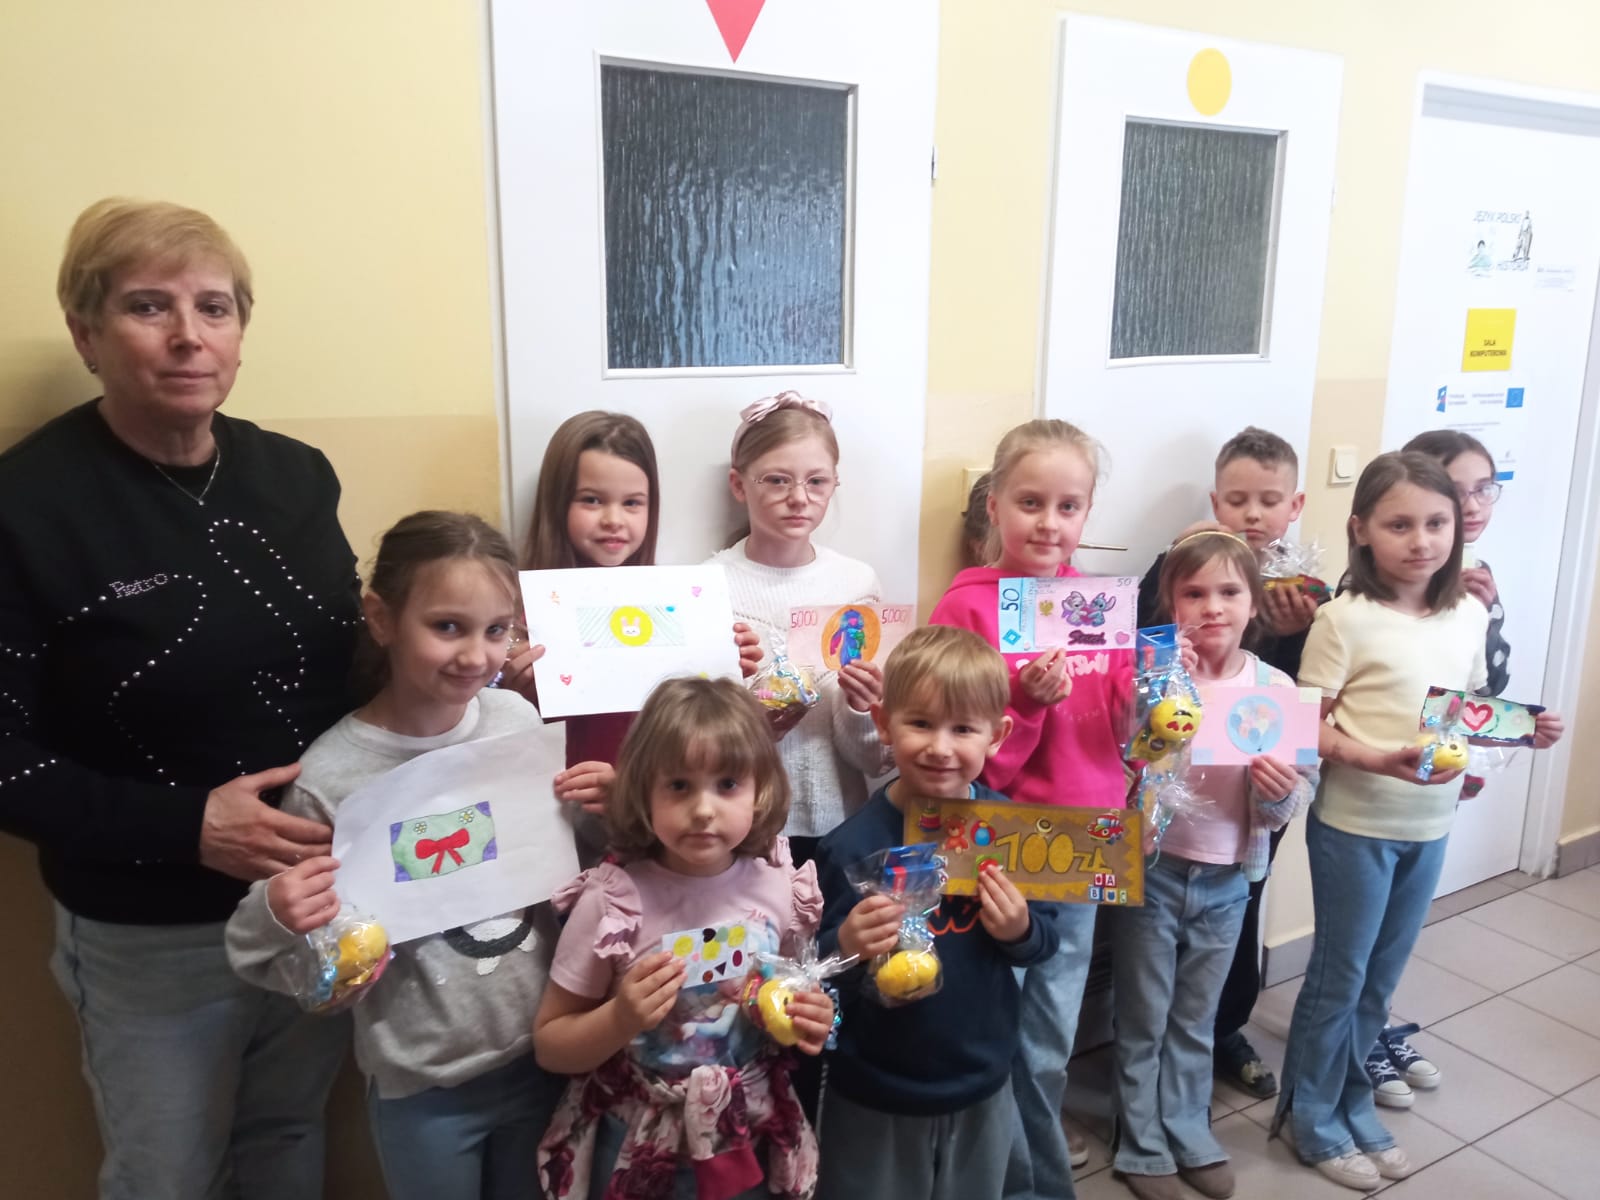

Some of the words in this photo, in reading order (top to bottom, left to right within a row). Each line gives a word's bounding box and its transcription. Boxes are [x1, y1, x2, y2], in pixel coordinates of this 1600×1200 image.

[108, 573, 168, 598] Retro
[1117, 577, 1133, 588] 50
[1001, 588, 1020, 612] 50
[790, 610, 818, 630] 5000
